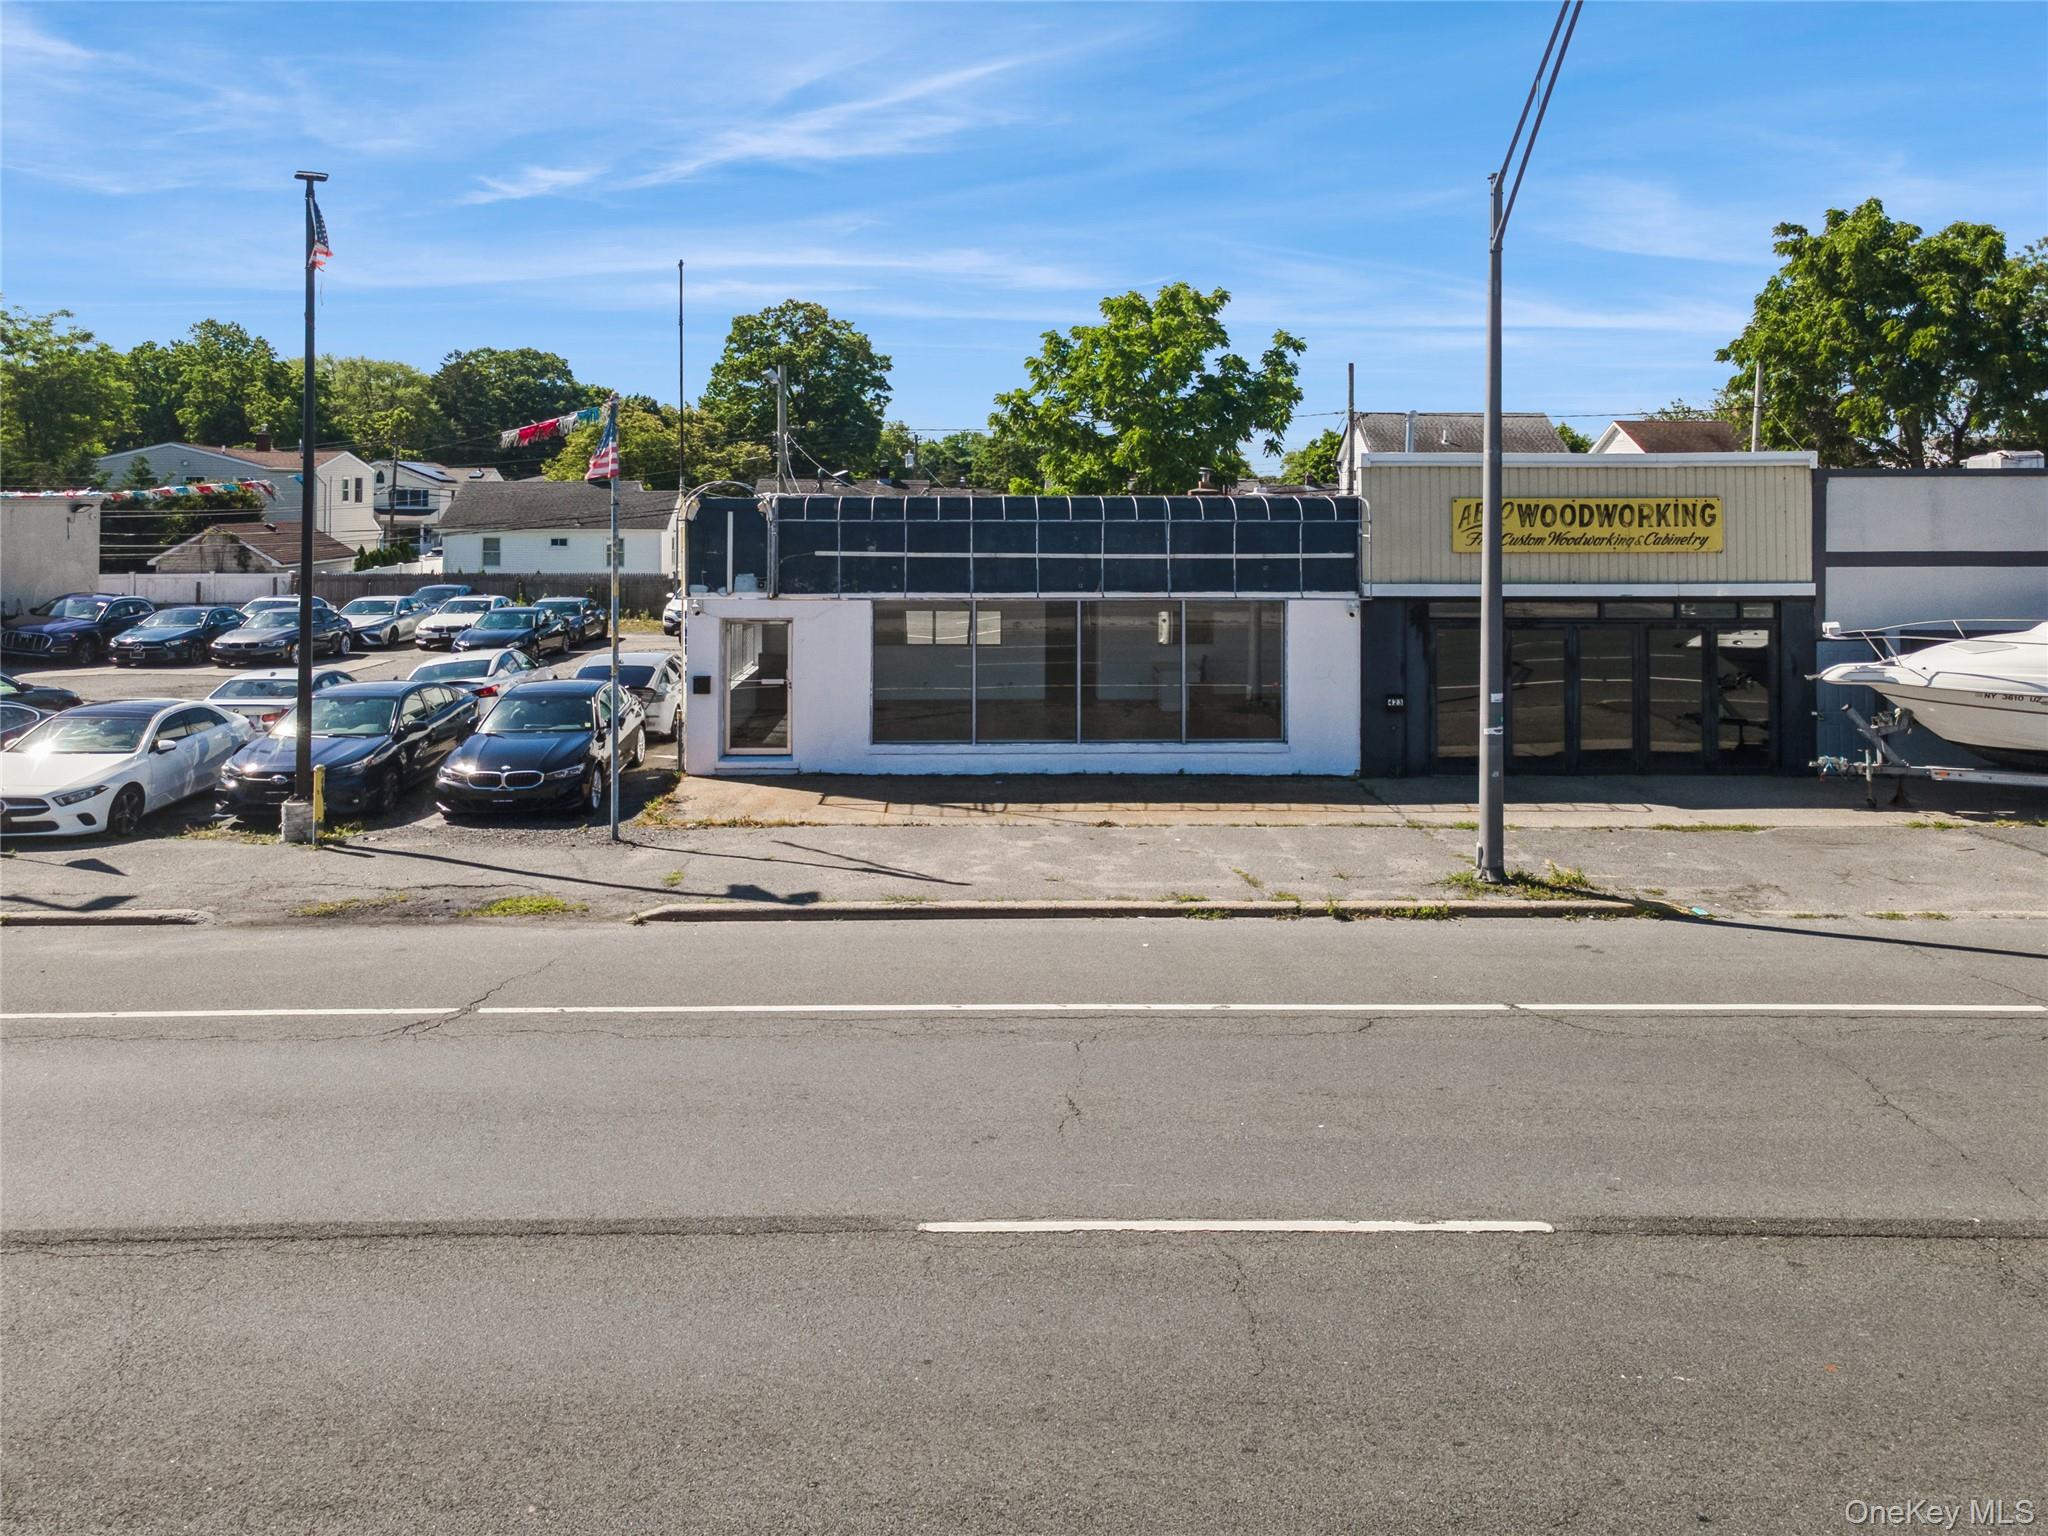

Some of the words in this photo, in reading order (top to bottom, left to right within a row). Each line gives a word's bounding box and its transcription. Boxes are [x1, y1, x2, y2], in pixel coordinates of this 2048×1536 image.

[1516, 503, 1717, 528] WOODWORKING
[1501, 532, 1546, 546] Custom
[1548, 531, 1634, 548] Woodworking
[1633, 535, 1643, 545] &
[1643, 532, 1709, 550] Cabinetry
